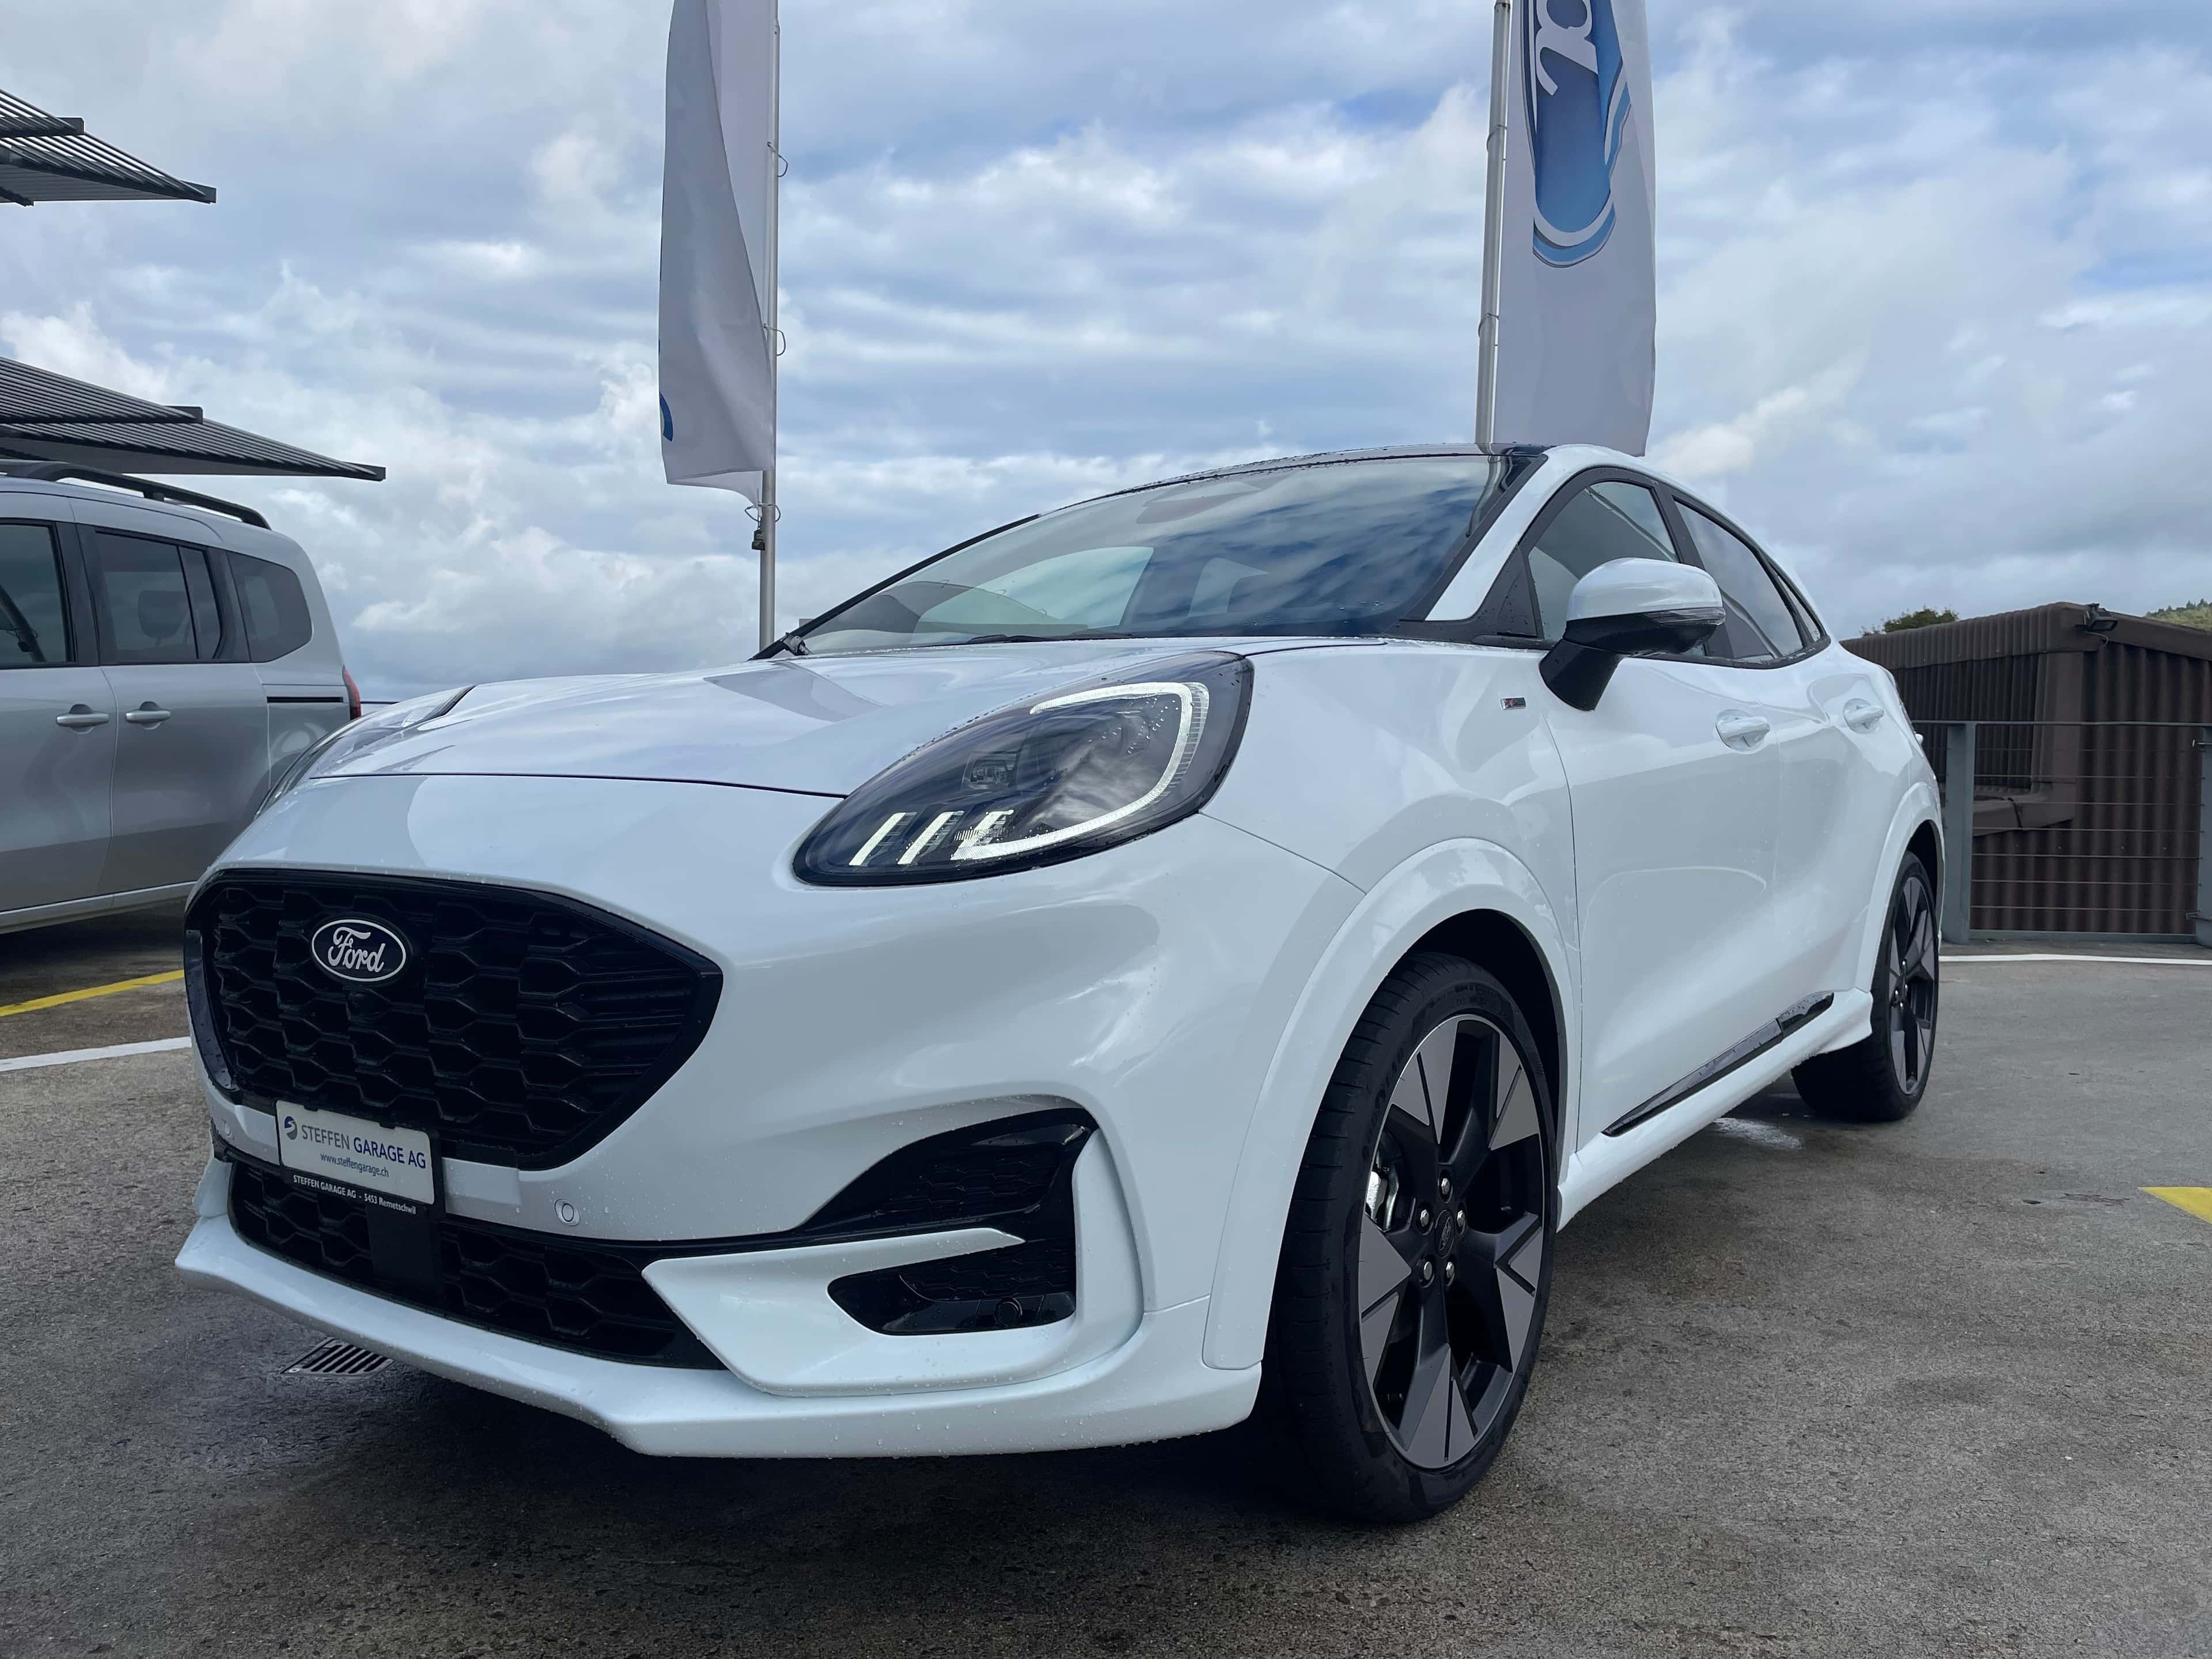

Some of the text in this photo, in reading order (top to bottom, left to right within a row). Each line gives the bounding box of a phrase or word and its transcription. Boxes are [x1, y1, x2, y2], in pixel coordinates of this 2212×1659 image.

[328, 927, 386, 973] Ford
[301, 1124, 426, 1169] STEFFEN GARAGE AG
[320, 1153, 389, 1177] www.steffengarage.ch
[293, 1175, 320, 1188] STEFFEN
[320, 1181, 346, 1196] GARAGE
[347, 1189, 357, 1199] AG
[364, 1193, 378, 1205] 5453
[378, 1197, 416, 1215] Remetschwil
